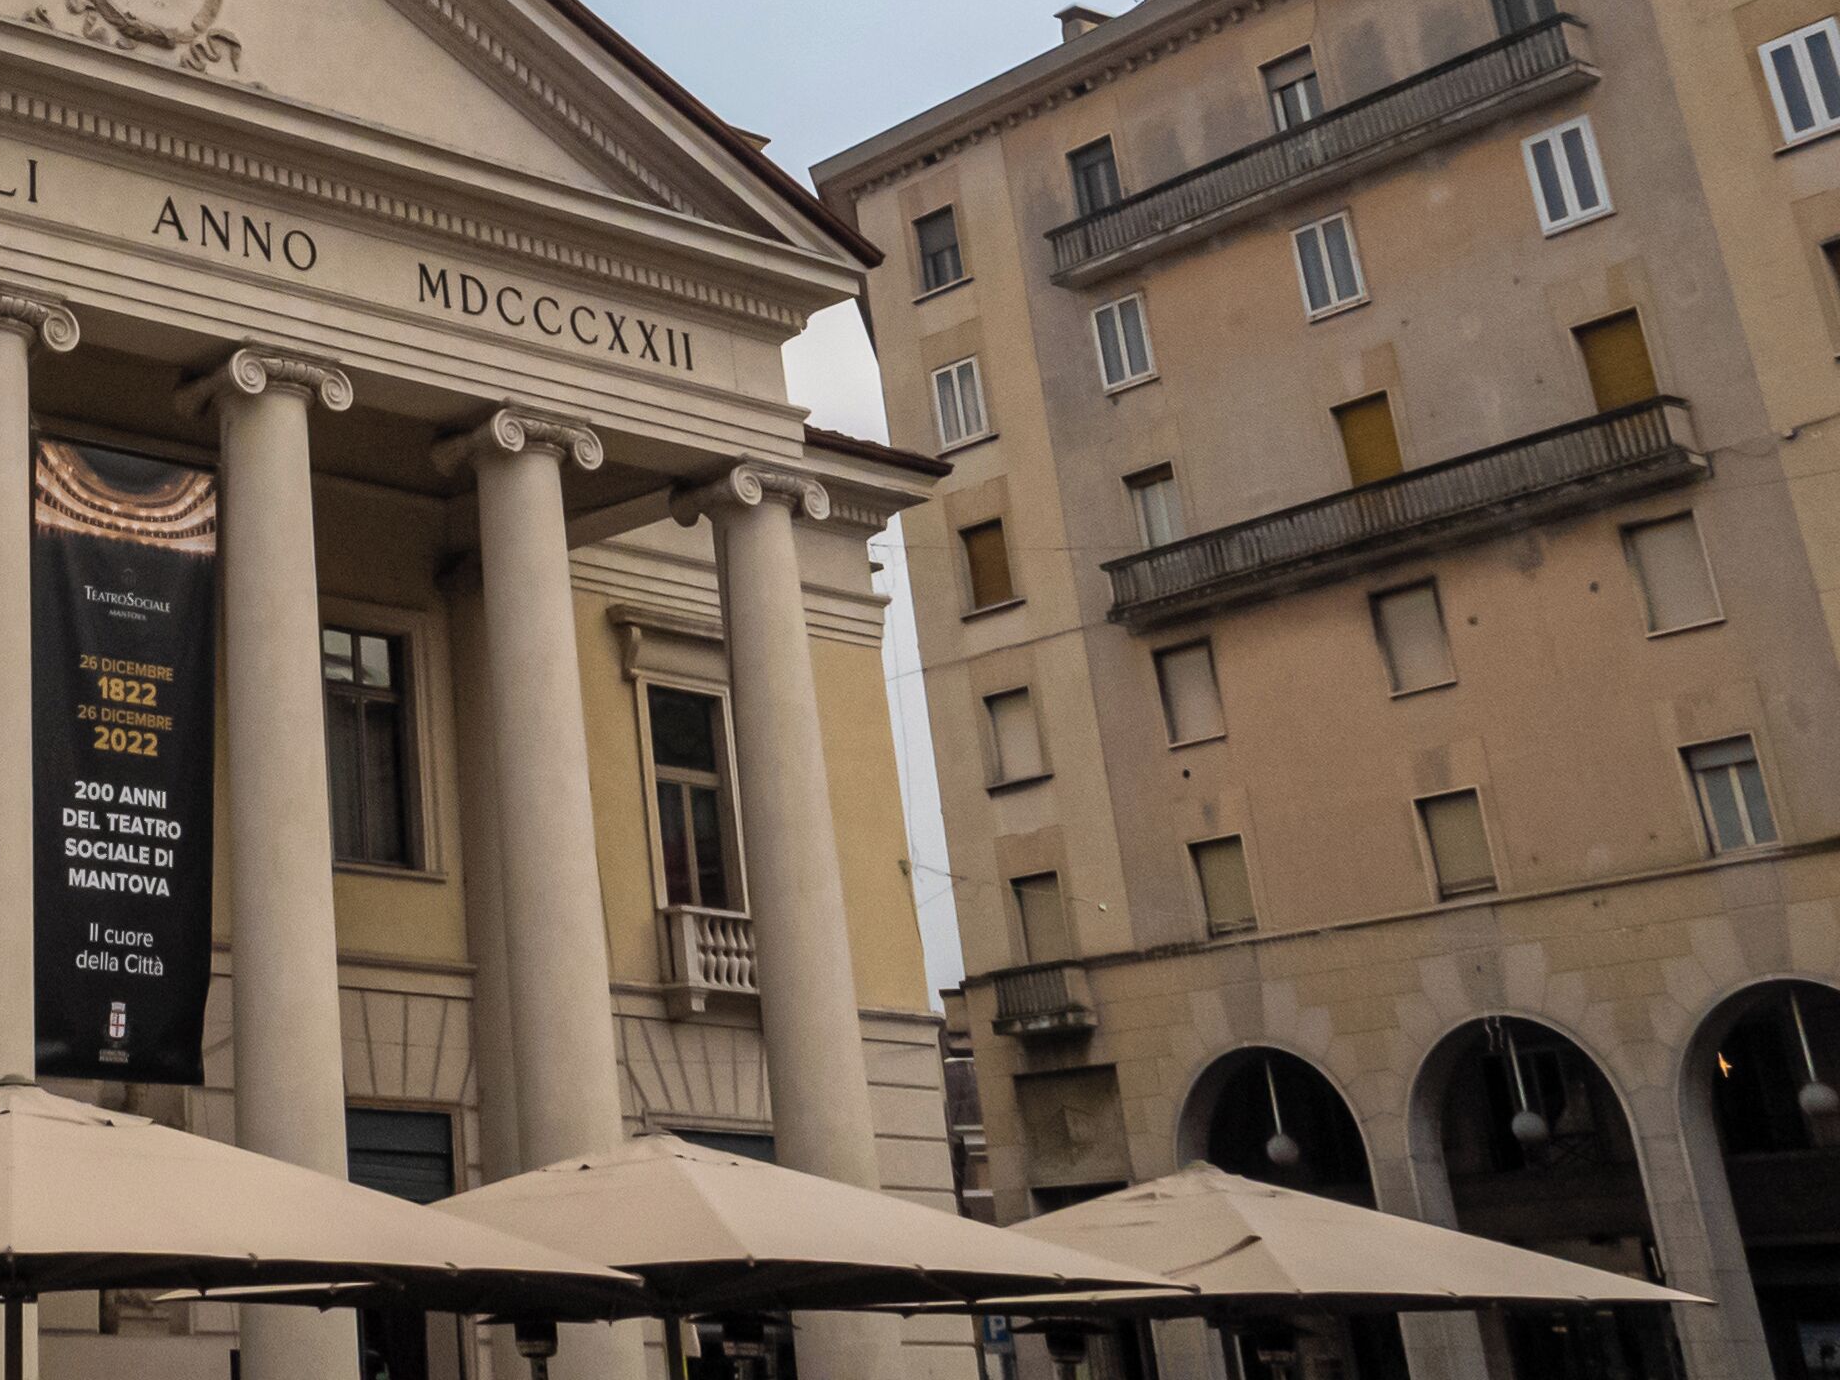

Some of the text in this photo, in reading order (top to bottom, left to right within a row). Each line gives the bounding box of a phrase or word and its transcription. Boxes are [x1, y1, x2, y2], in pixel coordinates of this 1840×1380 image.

[152, 196, 318, 272] ANNO
[418, 262, 694, 371] MDCCCXXII
[79, 654, 174, 681] 26 DICEMBRE
[98, 676, 157, 707] 1822
[78, 705, 173, 730] 26 DICEMBRE
[93, 725, 158, 757] 2022
[74, 780, 167, 809] 200 ANNI
[62, 807, 181, 840] DEL TEATRO
[64, 838, 173, 868] SOCIALE DI
[68, 868, 170, 897] MANTOVA
[89, 922, 154, 947] Il cuore
[76, 950, 164, 976] della Città
